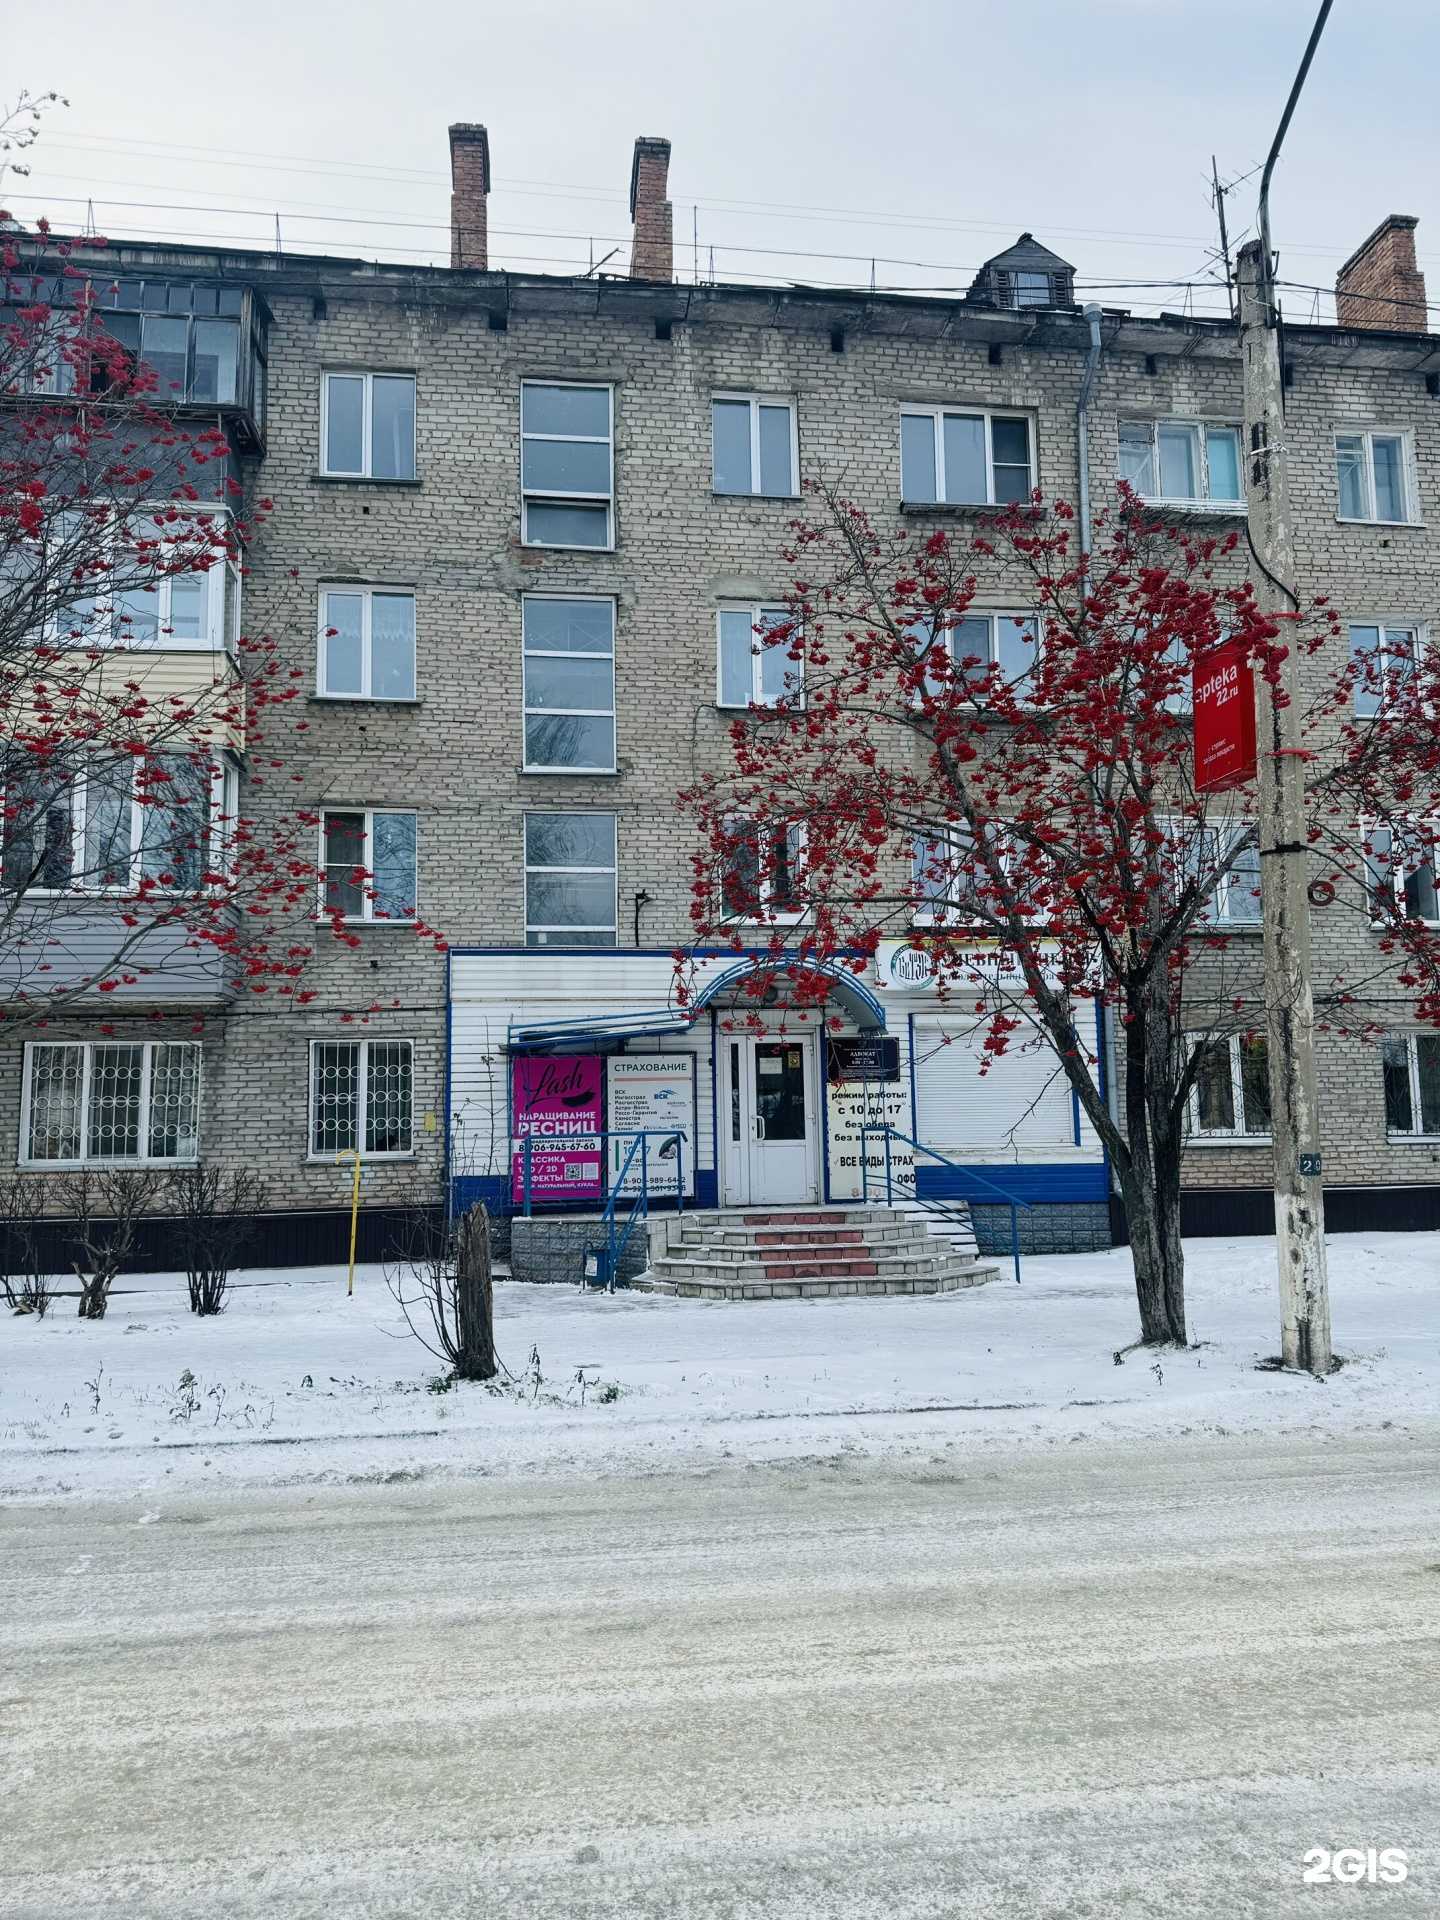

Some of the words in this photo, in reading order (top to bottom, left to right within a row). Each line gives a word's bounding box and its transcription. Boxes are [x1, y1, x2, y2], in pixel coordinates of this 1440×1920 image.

[1196, 665, 1238, 704] apteka
[1216, 685, 1239, 707] 22.ru
[614, 1063, 688, 1072] СТРАХОВАНИЕ
[831, 1092, 865, 1101] режим
[868, 1090, 907, 1101] работы:
[838, 1107, 845, 1115] с
[849, 1105, 864, 1115] 10
[867, 1107, 883, 1116] до
[887, 1104, 902, 1114] 17
[518, 1111, 597, 1122] НАРАЩИВАНИЕ
[518, 1120, 597, 1136] РЕСНИЦ
[845, 1120, 863, 1129] без
[834, 1133, 852, 1142] без
[518, 1142, 596, 1153] 8906-945-67-60
[517, 1156, 566, 1164] КАССИКА
[839, 1156, 857, 1167] ВСЕ
[859, 1156, 885, 1168] ВИДЫ
[546, 1165, 558, 1173] 2D
[517, 1174, 563, 1183] ЭФЕКТЫ
[897, 1173, 916, 1184] ОФО
